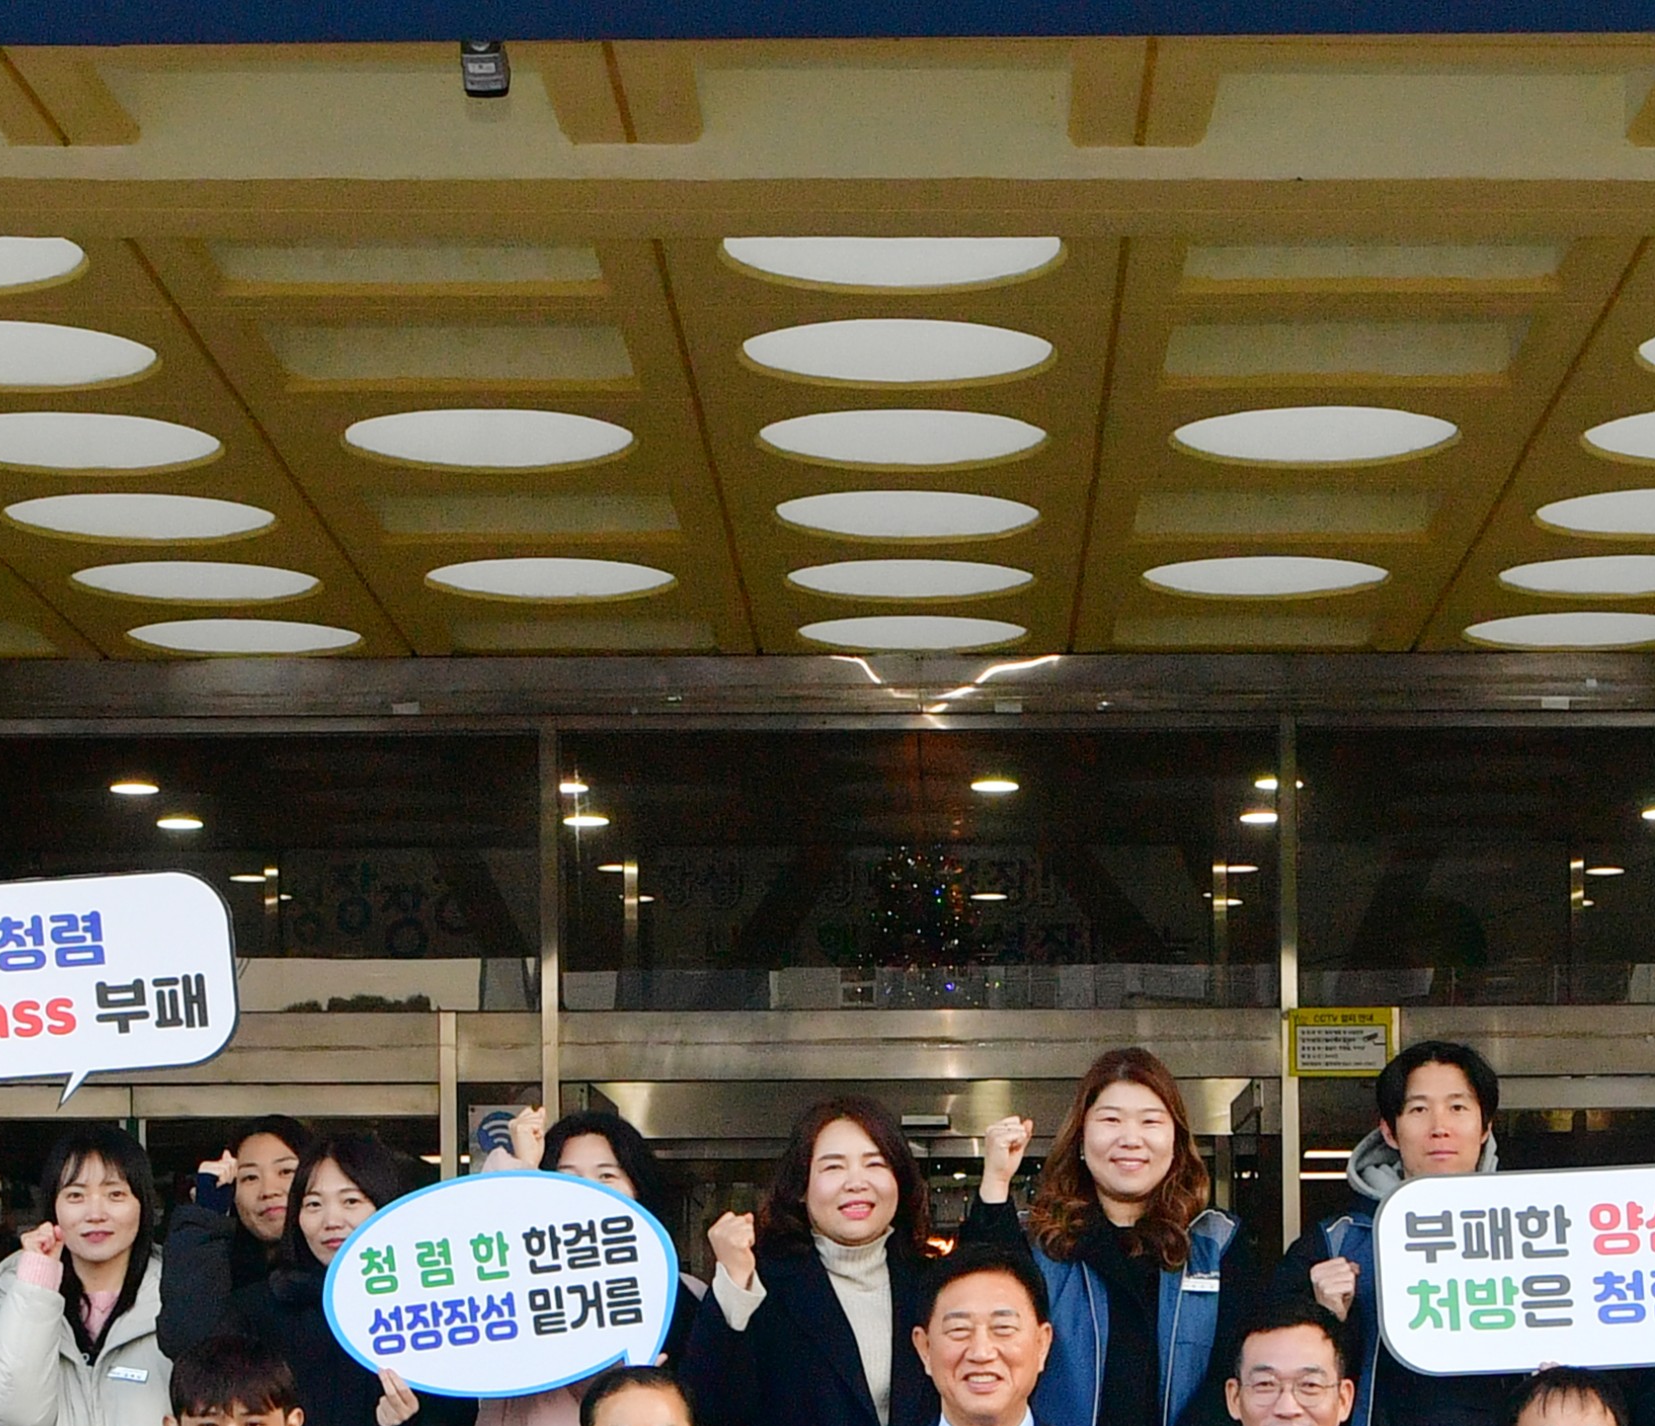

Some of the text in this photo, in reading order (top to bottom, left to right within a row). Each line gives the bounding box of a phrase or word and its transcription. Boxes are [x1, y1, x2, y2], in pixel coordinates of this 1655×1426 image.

[95, 973, 208, 1034] 부패
[522, 1215, 639, 1275] 한걸음
[1405, 1205, 1571, 1263] 부패한
[369, 1276, 644, 1356] 성장장성 밑거름
[1407, 1275, 1573, 1330] 처방은
